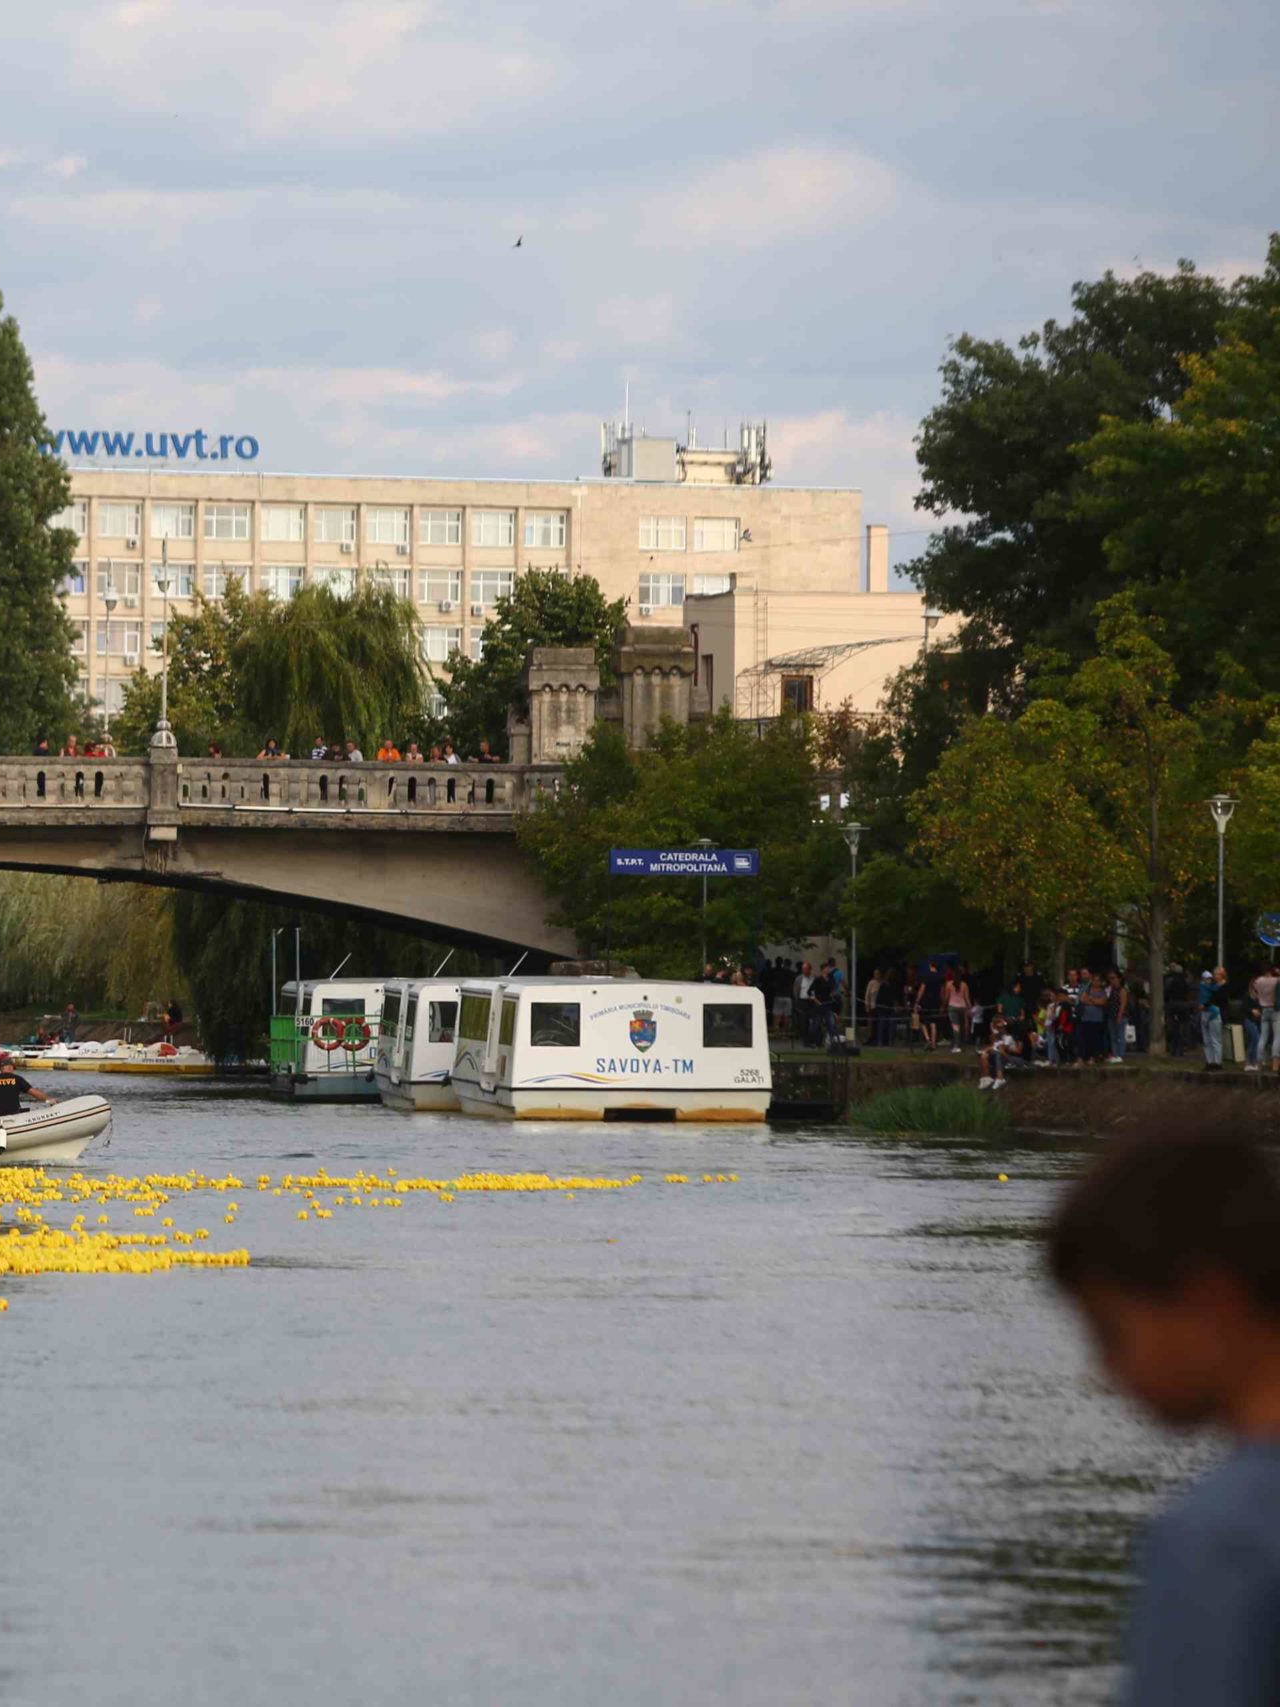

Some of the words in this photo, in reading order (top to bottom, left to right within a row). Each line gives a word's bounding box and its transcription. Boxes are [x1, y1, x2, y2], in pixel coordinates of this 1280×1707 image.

[36, 429, 259, 459] www.uvt.ro
[659, 852, 718, 861] CATEDRALA
[296, 1017, 314, 1026] 5160
[596, 1058, 694, 1074] SAVOYA-TM
